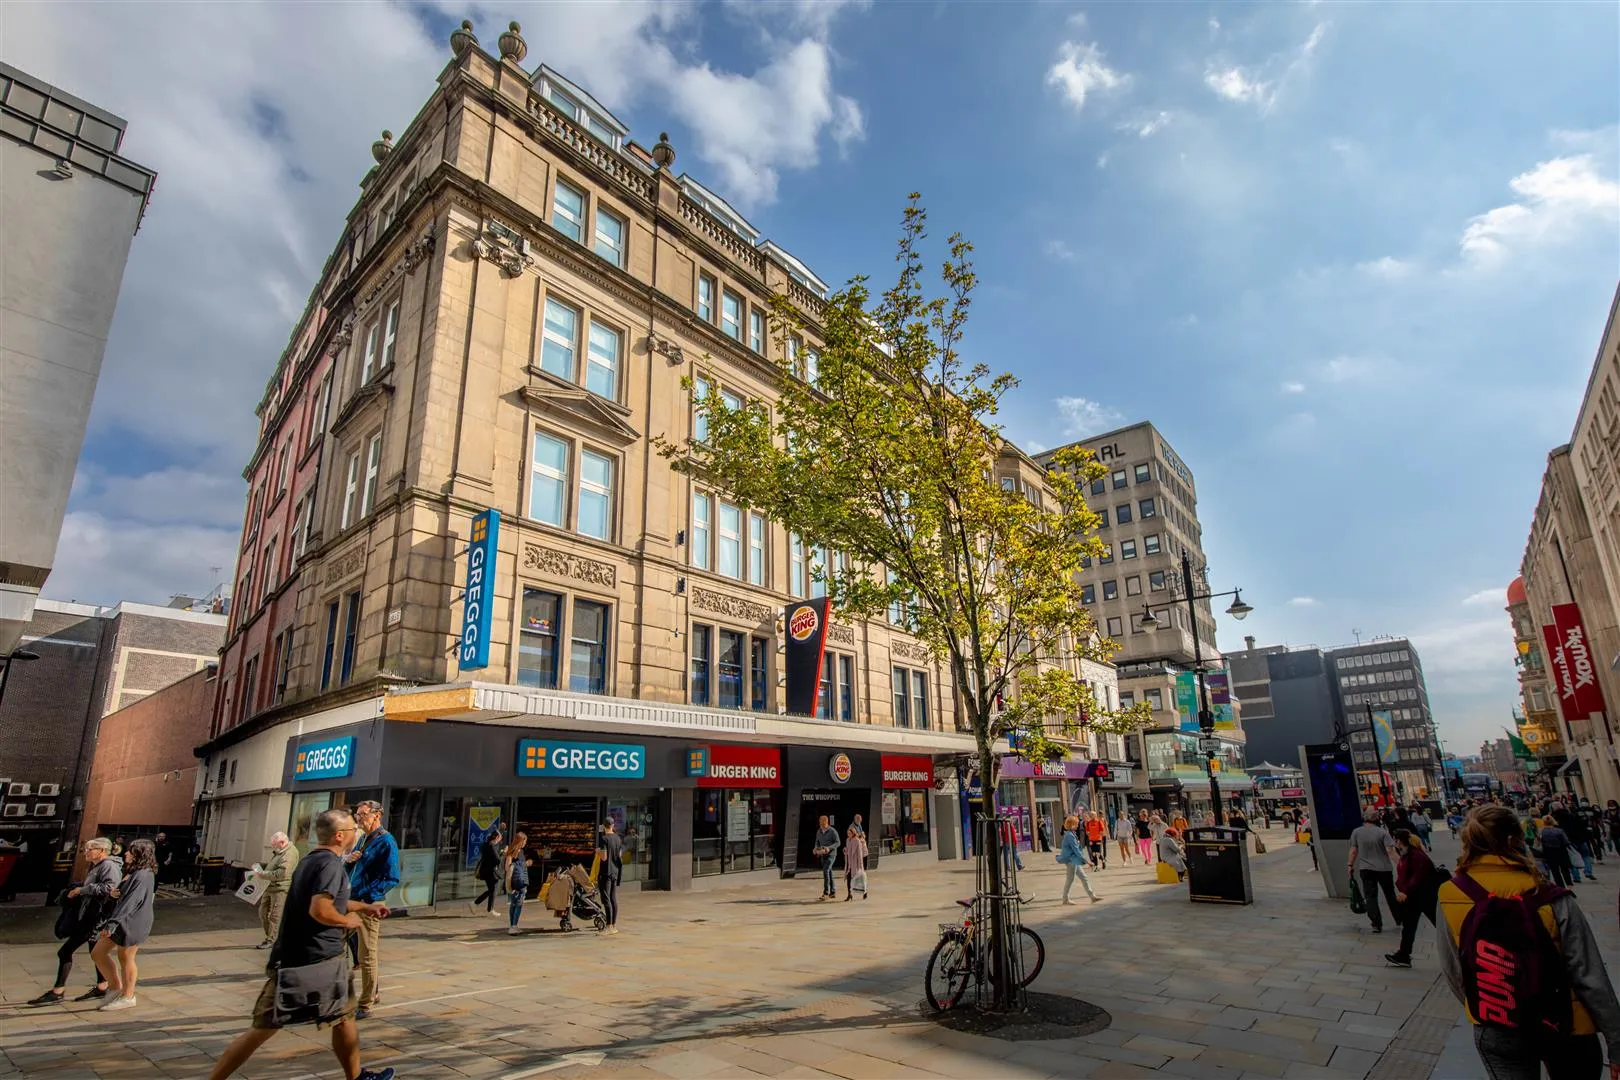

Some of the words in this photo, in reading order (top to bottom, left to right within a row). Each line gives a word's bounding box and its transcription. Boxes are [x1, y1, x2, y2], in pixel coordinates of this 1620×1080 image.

[464, 547, 484, 661] GREGGS
[791, 611, 815, 627] BURGER
[791, 618, 816, 636] KING
[306, 745, 347, 772] GREGGS
[552, 748, 640, 771] GREGGS
[711, 765, 748, 779] URGER
[750, 766, 777, 779] KING
[884, 770, 911, 781] BURGER
[912, 771, 928, 782] KING
[1041, 762, 1066, 776] NatWest
[1477, 939, 1517, 1028] PUMA
